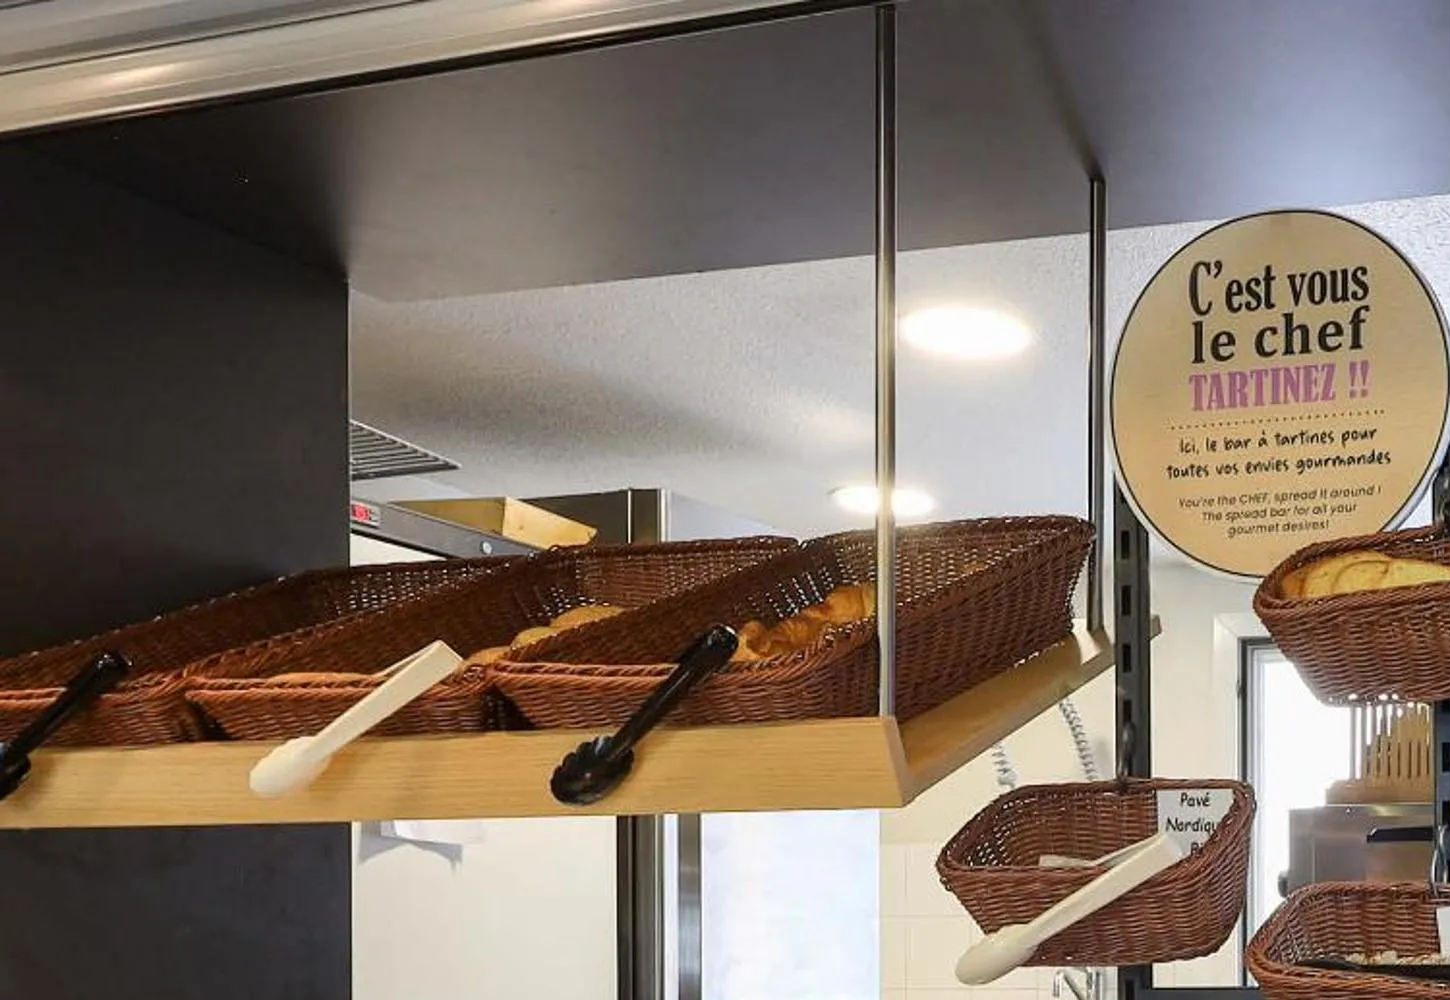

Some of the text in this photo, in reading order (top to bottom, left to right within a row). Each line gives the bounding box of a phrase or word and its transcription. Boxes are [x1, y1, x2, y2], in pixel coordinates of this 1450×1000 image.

[1288, 265, 1370, 307] vous
[1191, 305, 1371, 364] le chef
[1189, 363, 1336, 412] TARTINEZ
[1206, 436, 1217, 452] le
[1224, 435, 1251, 450] bar
[1258, 431, 1269, 447] à
[1274, 429, 1335, 446] tartines
[1341, 428, 1378, 448] pour
[1166, 449, 1392, 480] toutes vos envies gourmandes
[1217, 493, 1237, 506] the
[1274, 487, 1317, 504] spread
[1330, 485, 1376, 499] around
[1202, 503, 1358, 523] The spread bar for all your
[1227, 519, 1330, 539] gourmet desires!
[1180, 791, 1211, 807] Pavé
